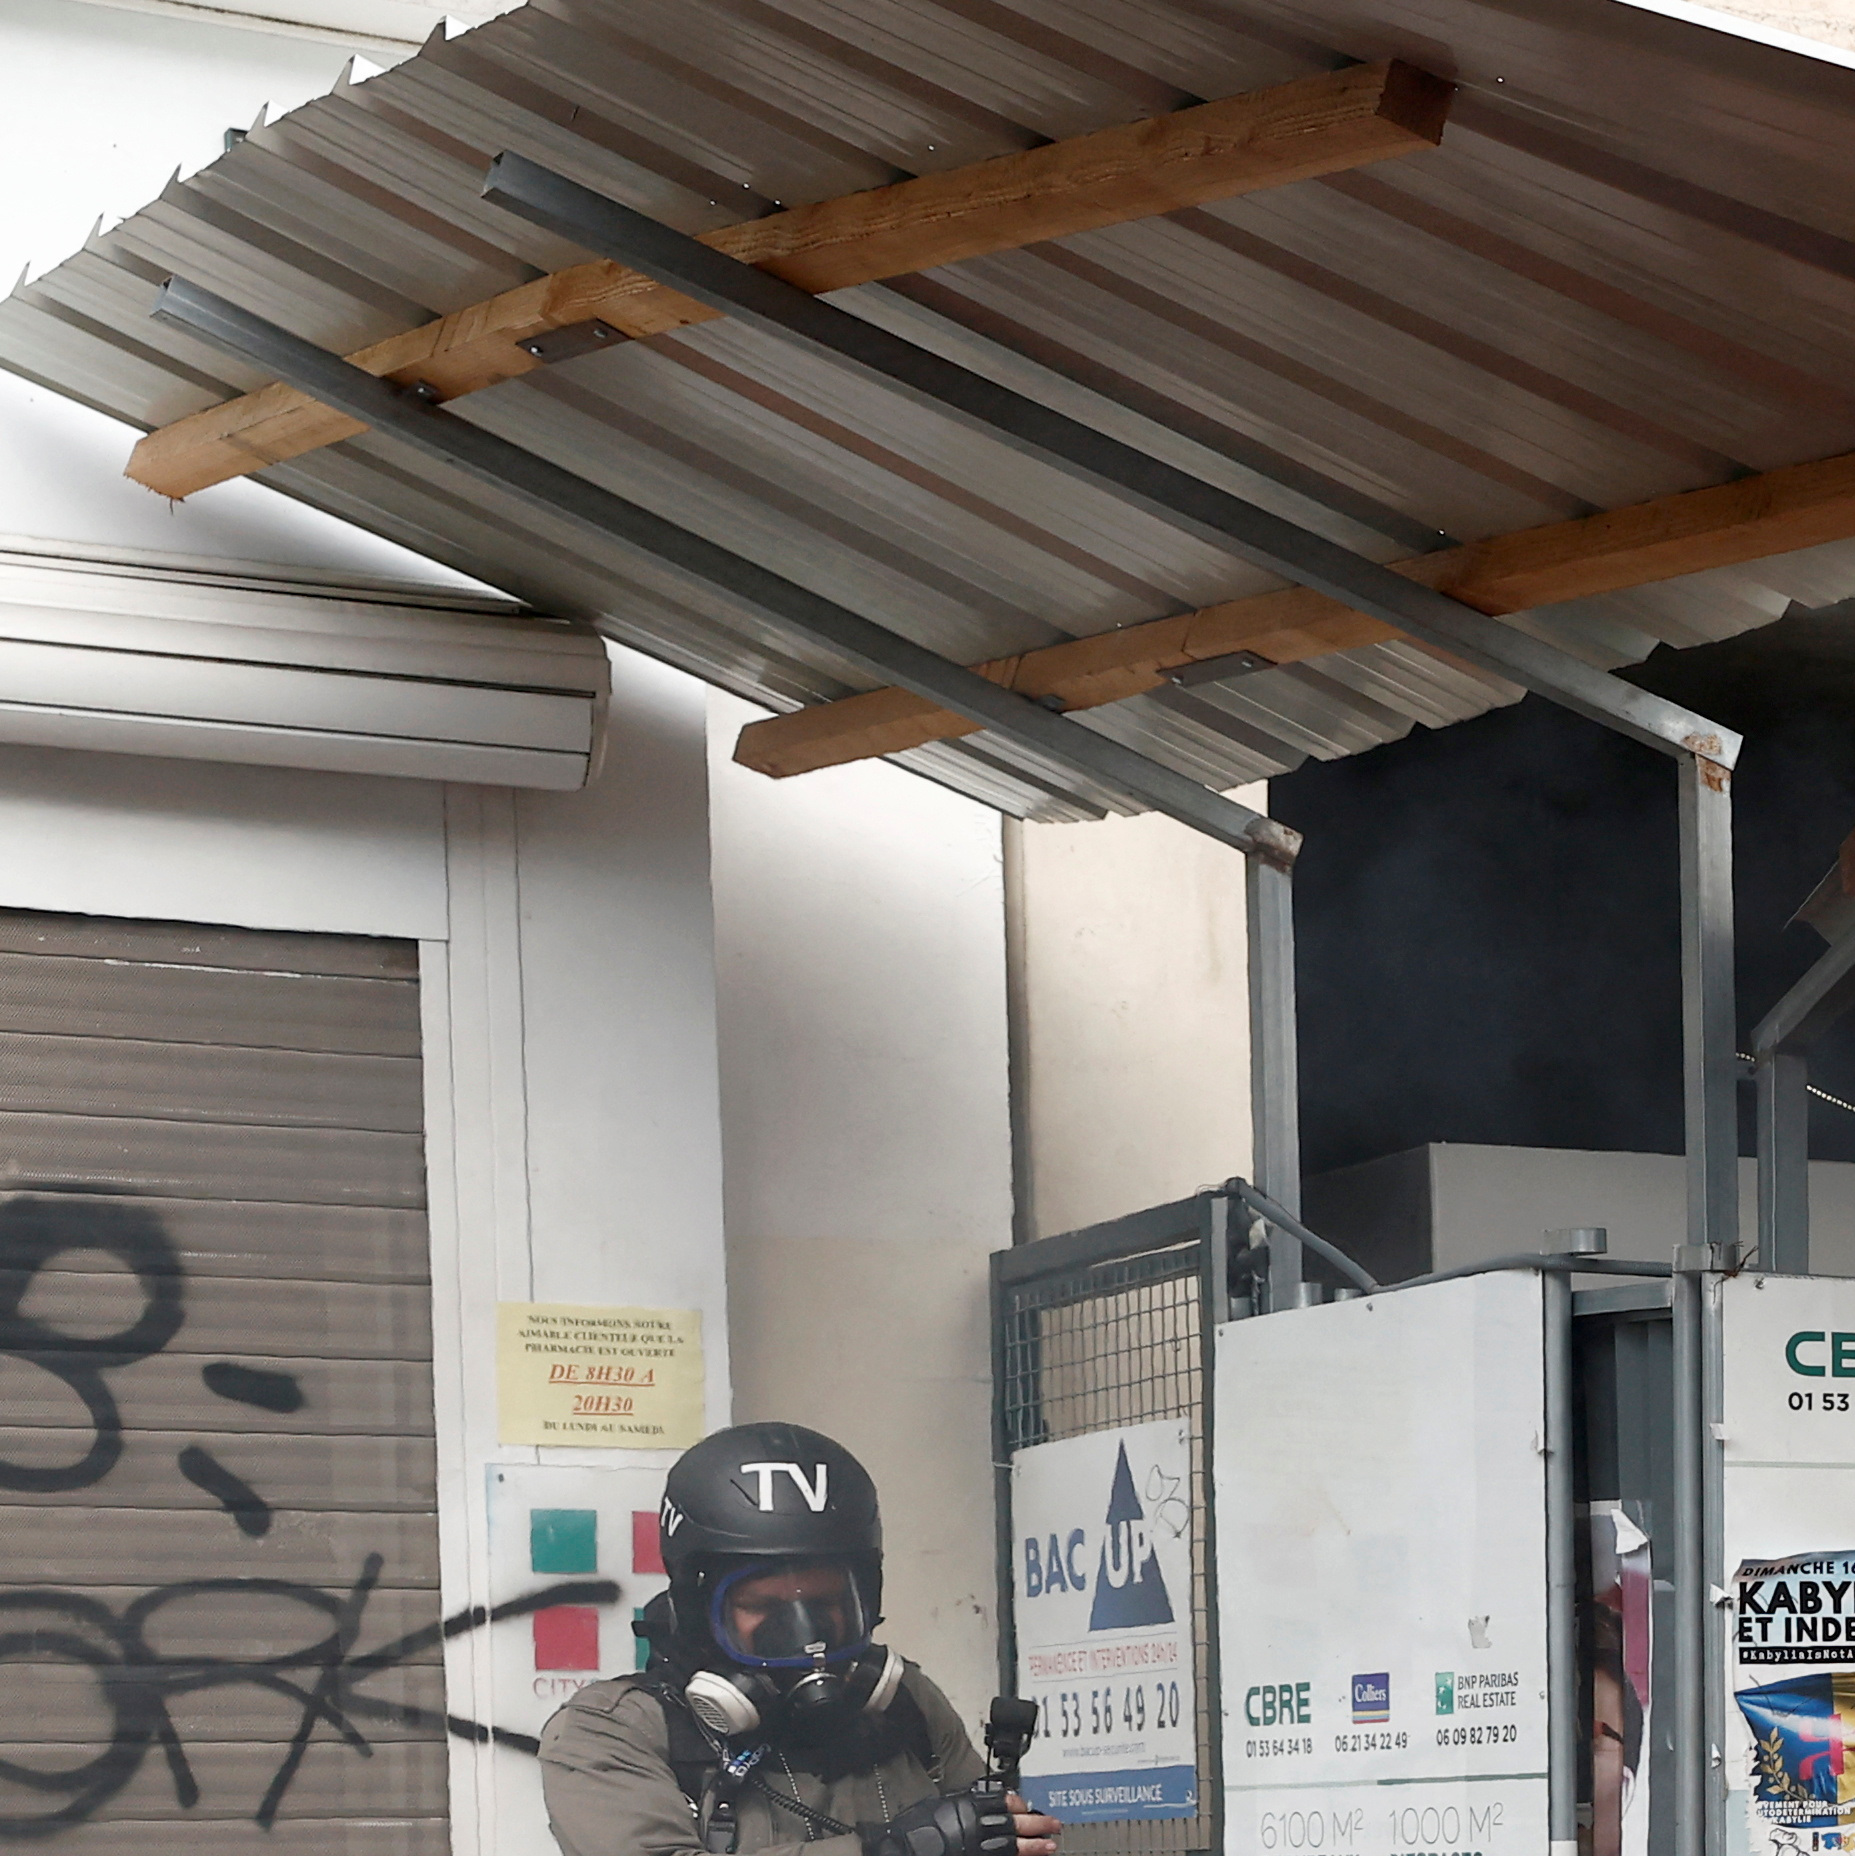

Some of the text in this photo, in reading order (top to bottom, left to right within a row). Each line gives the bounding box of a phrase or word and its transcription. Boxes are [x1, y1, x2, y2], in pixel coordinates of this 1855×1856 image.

[550, 1364, 655, 1383] DE 8H30 A
[573, 1394, 633, 1412] 20H30
[1788, 1392, 1813, 1412] 01
[1822, 1392, 1849, 1413] 53
[740, 1462, 828, 1513] TV
[1025, 1520, 1152, 1598] BAC UP
[1742, 1560, 1835, 1577] DIMANCHE
[1738, 1616, 1774, 1643] ET
[1354, 1680, 1387, 1704] Colliers
[1458, 1671, 1519, 1691] BNP PARIBAS
[1060, 1692, 1081, 1738] 53
[1092, 1687, 1112, 1735] 56
[1123, 1684, 1145, 1732] 49
[1157, 1681, 1179, 1729] 20
[1244, 1682, 1311, 1727] CBRE
[1458, 1690, 1516, 1710] REAL ESTATE
[1335, 1731, 1408, 1753] 06 21 34 22 49
[1436, 1724, 1517, 1746] 06 09 82 79 20
[1246, 1740, 1257, 1758] 01
[1259, 1740, 1270, 1757] 53
[1287, 1739, 1299, 1755] 34
[1802, 1800, 1829, 1809] POUR
[1261, 1811, 1325, 1849] 6100
[1389, 1806, 1460, 1846] 1000
